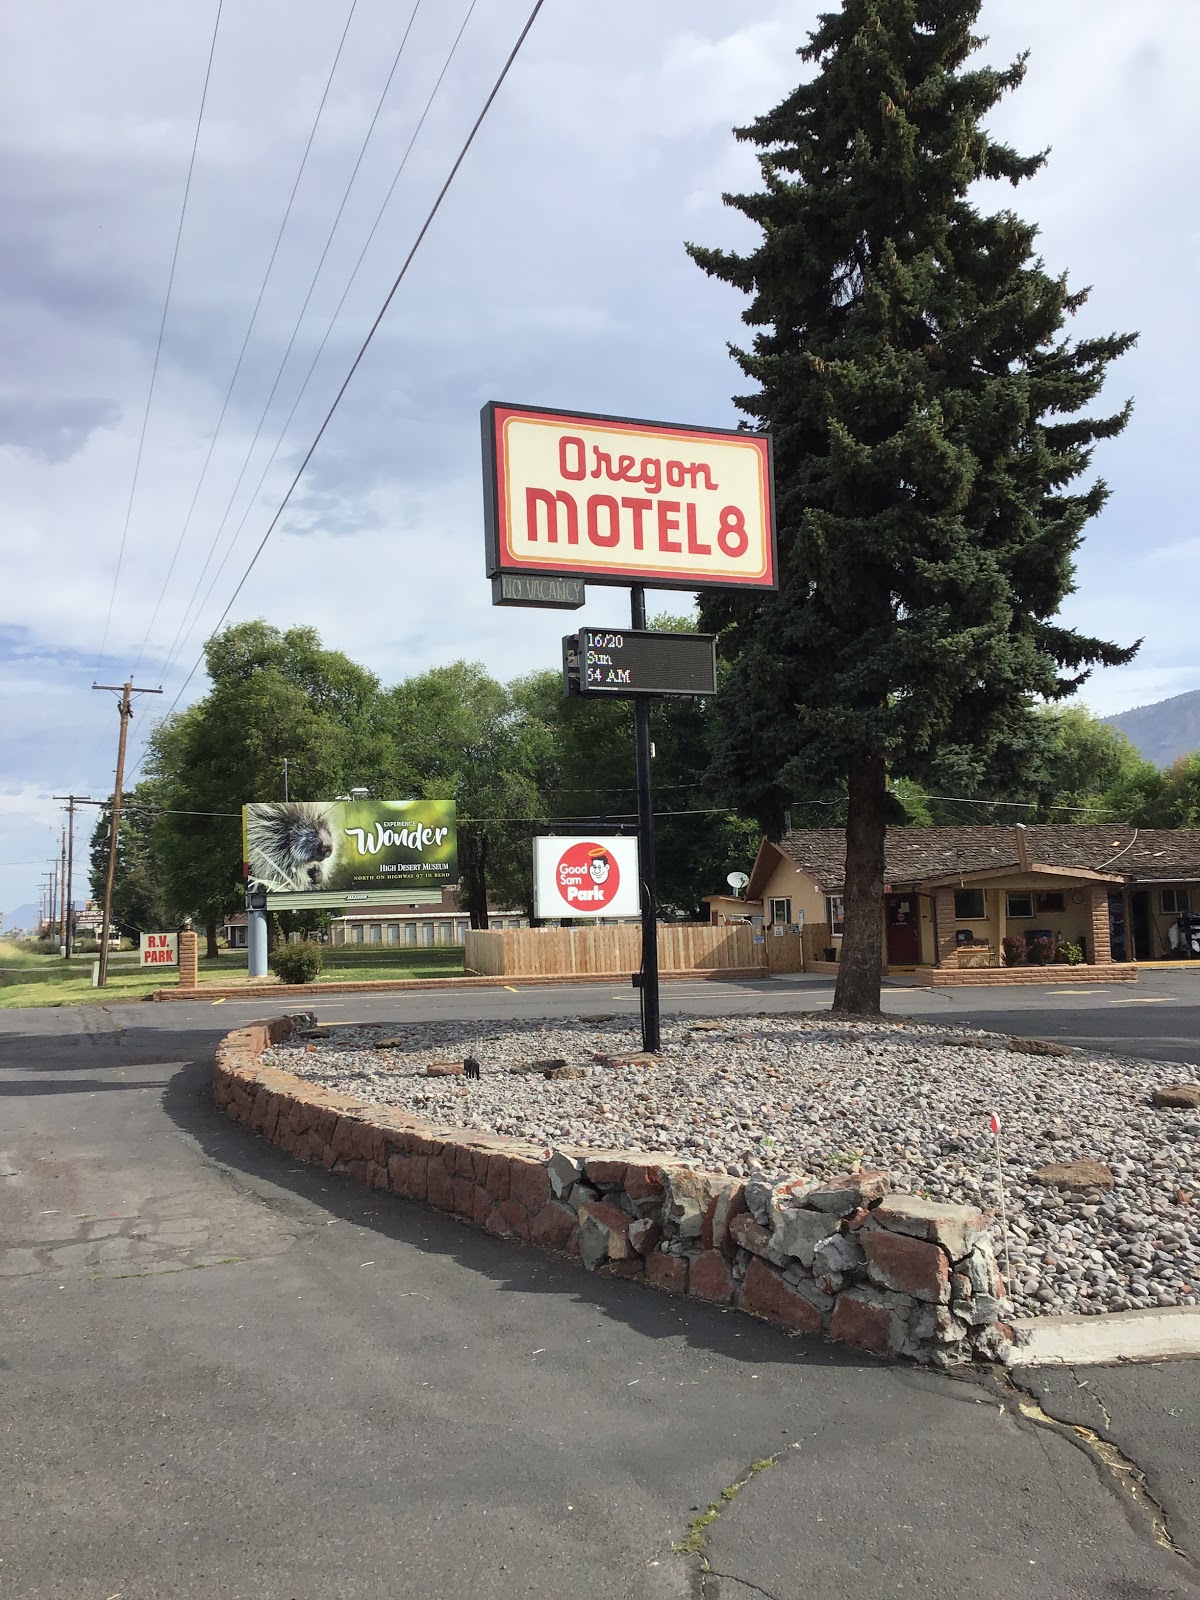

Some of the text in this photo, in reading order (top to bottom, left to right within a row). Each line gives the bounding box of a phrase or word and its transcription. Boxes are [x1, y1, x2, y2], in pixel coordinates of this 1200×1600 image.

[559, 435, 719, 494] Oregon
[502, 578, 580, 600] NO VACANCY
[587, 633, 624, 648] 16/20
[587, 650, 613, 665] Sun
[587, 668, 631, 683] 54 AM
[383, 820, 417, 828] EXPERIENCE
[344, 822, 448, 855] Wonder
[380, 862, 449, 872] HIGH DESERT MUSEUM
[559, 863, 588, 875] Good
[560, 874, 582, 885] Sam
[567, 885, 605, 901] Park
[148, 935, 170, 948] R.V.
[144, 950, 173, 963] PARK
